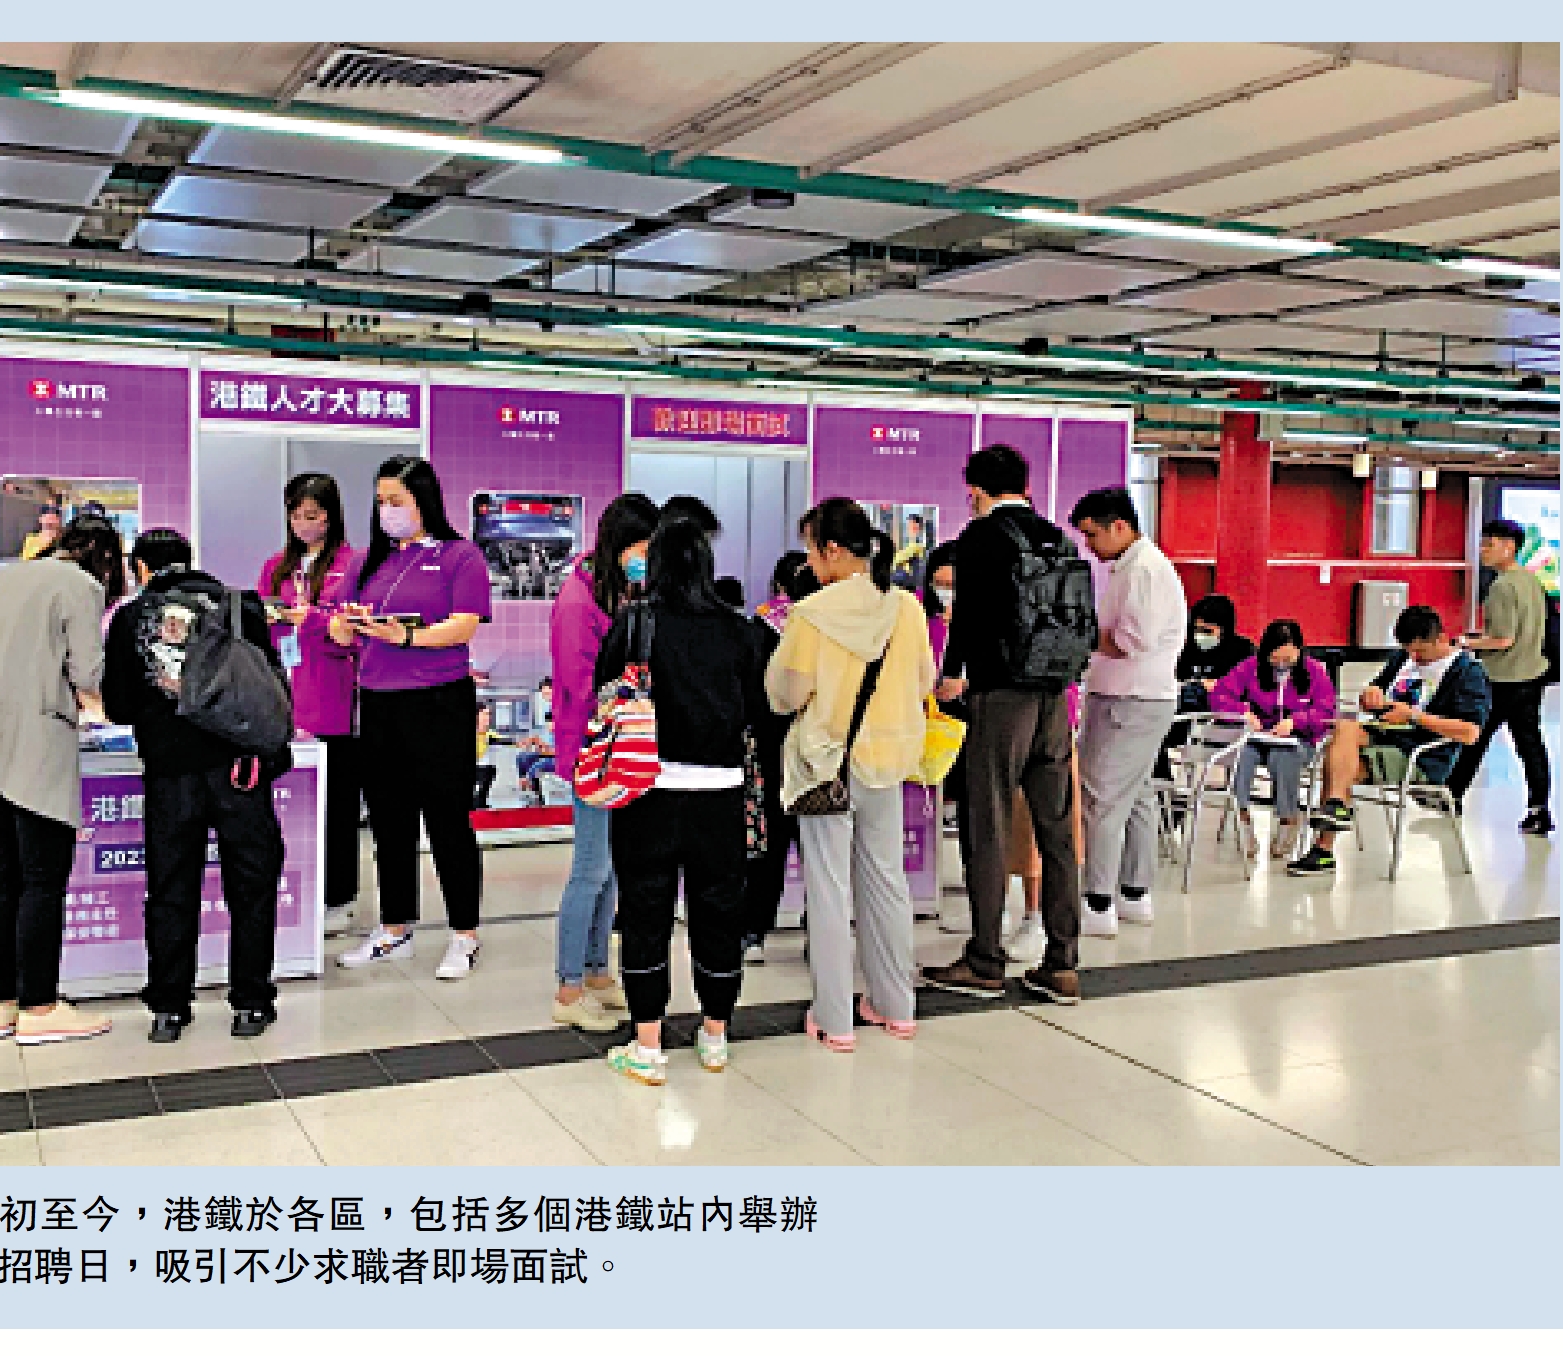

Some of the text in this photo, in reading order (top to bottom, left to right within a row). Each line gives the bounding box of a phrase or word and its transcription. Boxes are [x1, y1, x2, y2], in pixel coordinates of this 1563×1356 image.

[57, 382, 109, 401] MTR
[210, 379, 412, 419] 港鐵人才大募集
[517, 409, 560, 427] MTR
[887, 427, 922, 443] MTR
